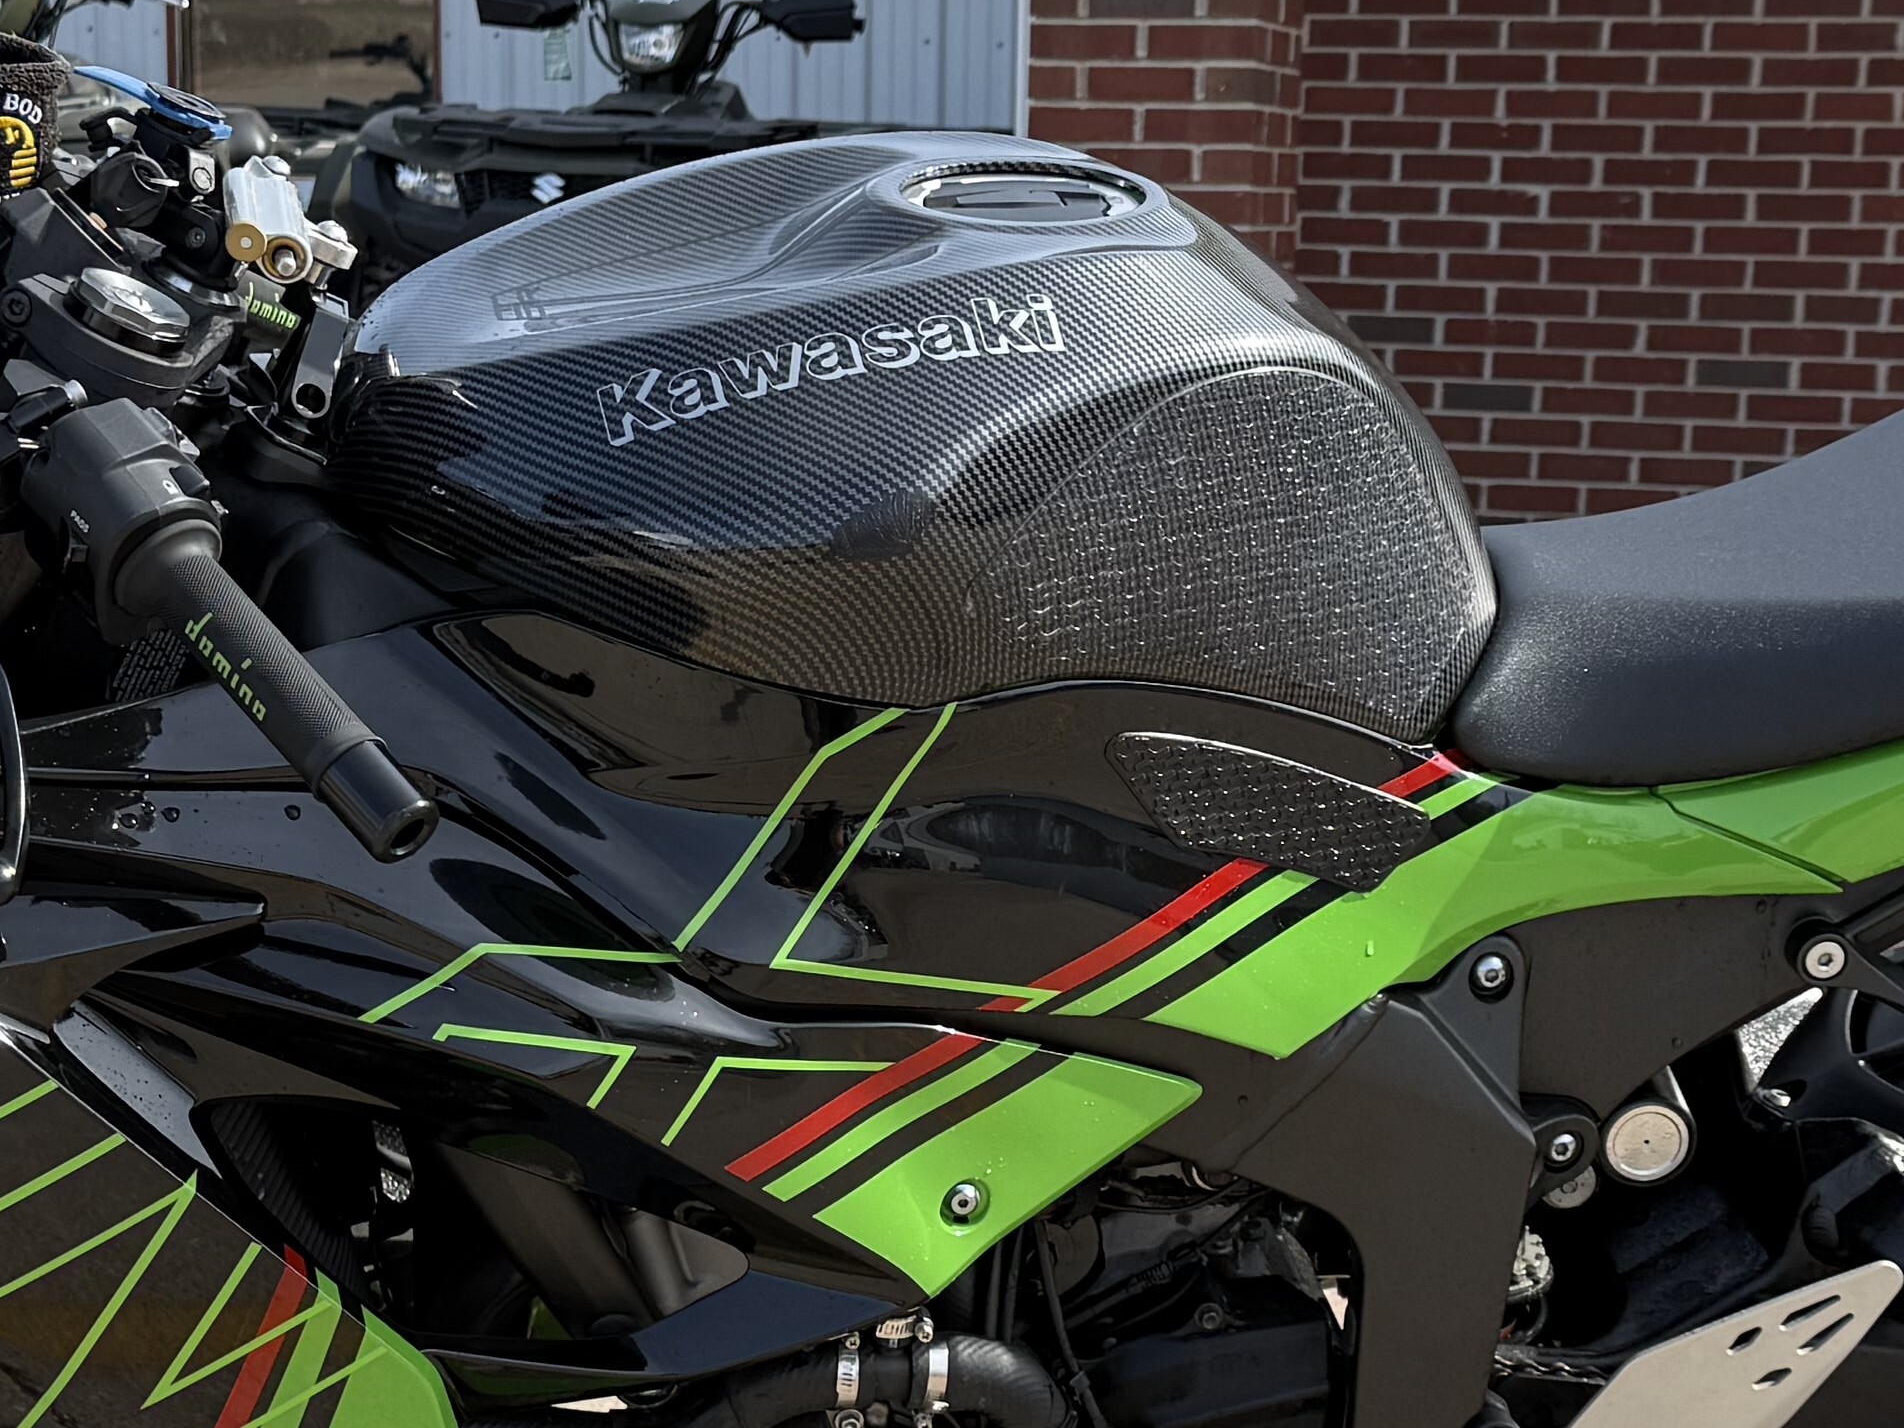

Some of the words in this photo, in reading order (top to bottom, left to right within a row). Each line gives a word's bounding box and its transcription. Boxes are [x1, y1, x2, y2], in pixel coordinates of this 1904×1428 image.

[2, 93, 43, 124] BOD
[596, 293, 1066, 447] Kawasaki
[185, 612, 267, 722] domino
